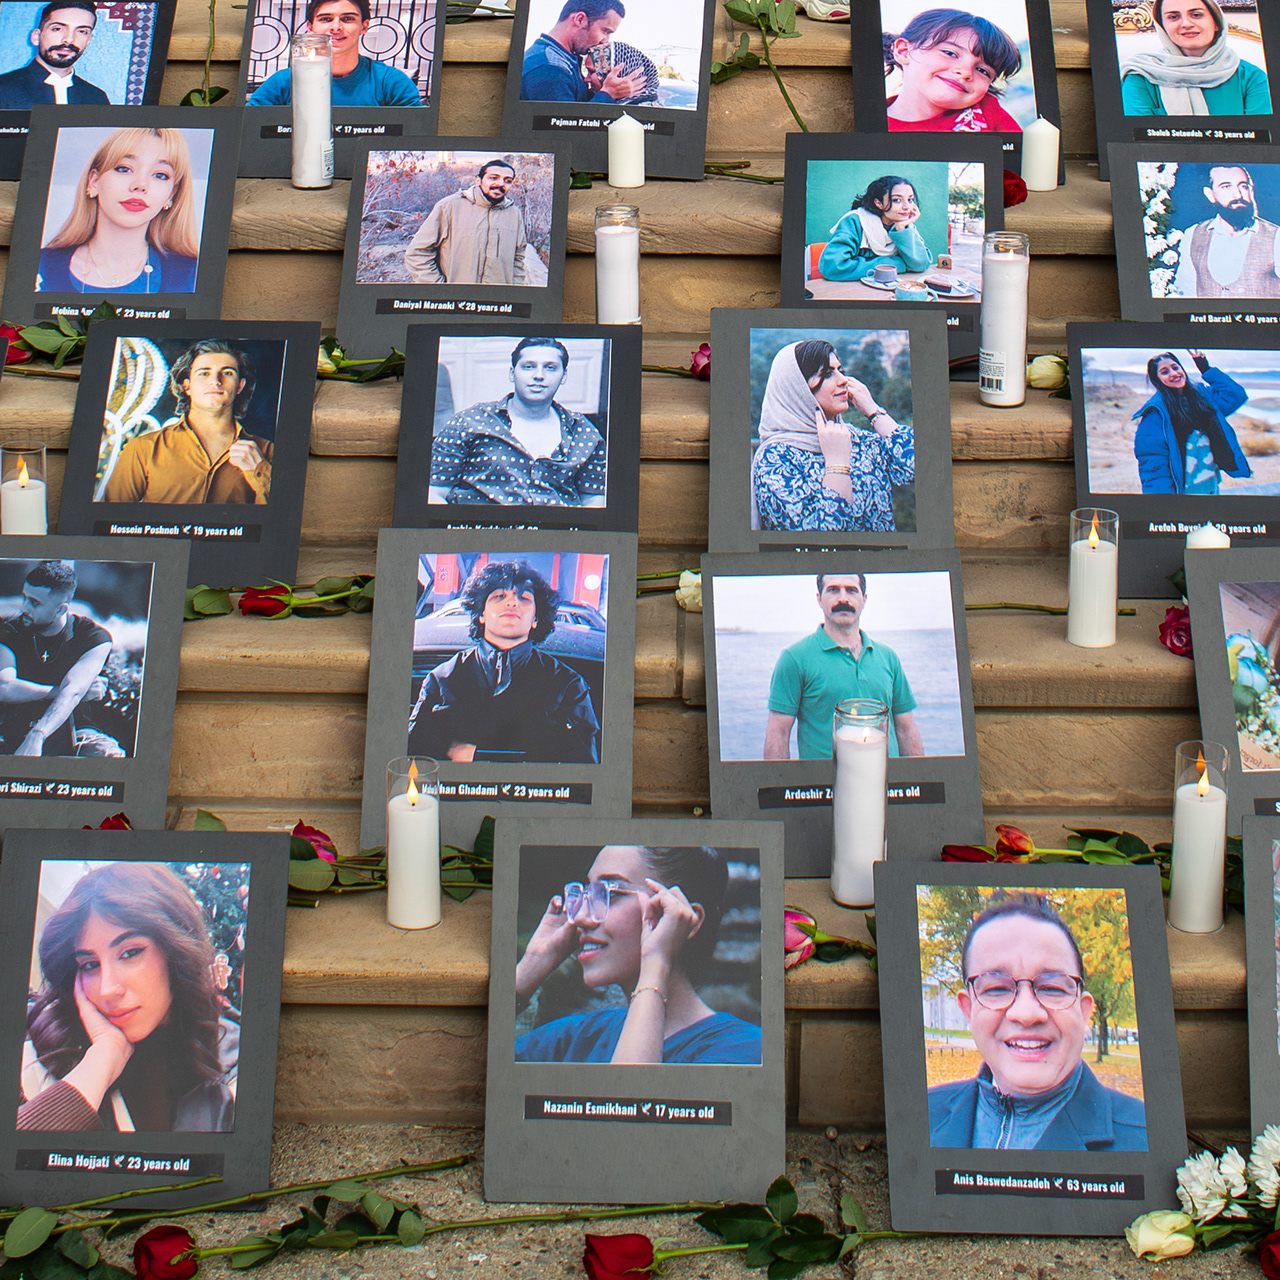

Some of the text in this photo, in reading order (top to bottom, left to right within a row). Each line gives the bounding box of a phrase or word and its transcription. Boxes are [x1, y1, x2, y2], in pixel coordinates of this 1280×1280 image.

[394, 300, 422, 309] Daniyal
[423, 301, 454, 309] Maranki
[466, 302, 476, 311] 28
[500, 304, 512, 312] old
[11, 783, 42, 793] Shirazi
[57, 784, 69, 794] 23
[71, 787, 96, 797] years
[98, 786, 113, 797] old
[544, 1101, 714, 1119] Nazanin Esmikhani 17 years old
[48, 1154, 189, 1171] Elina Hojjati 23 years old
[954, 1173, 1124, 1193] Anis Baswedanzadeh 63 years old
